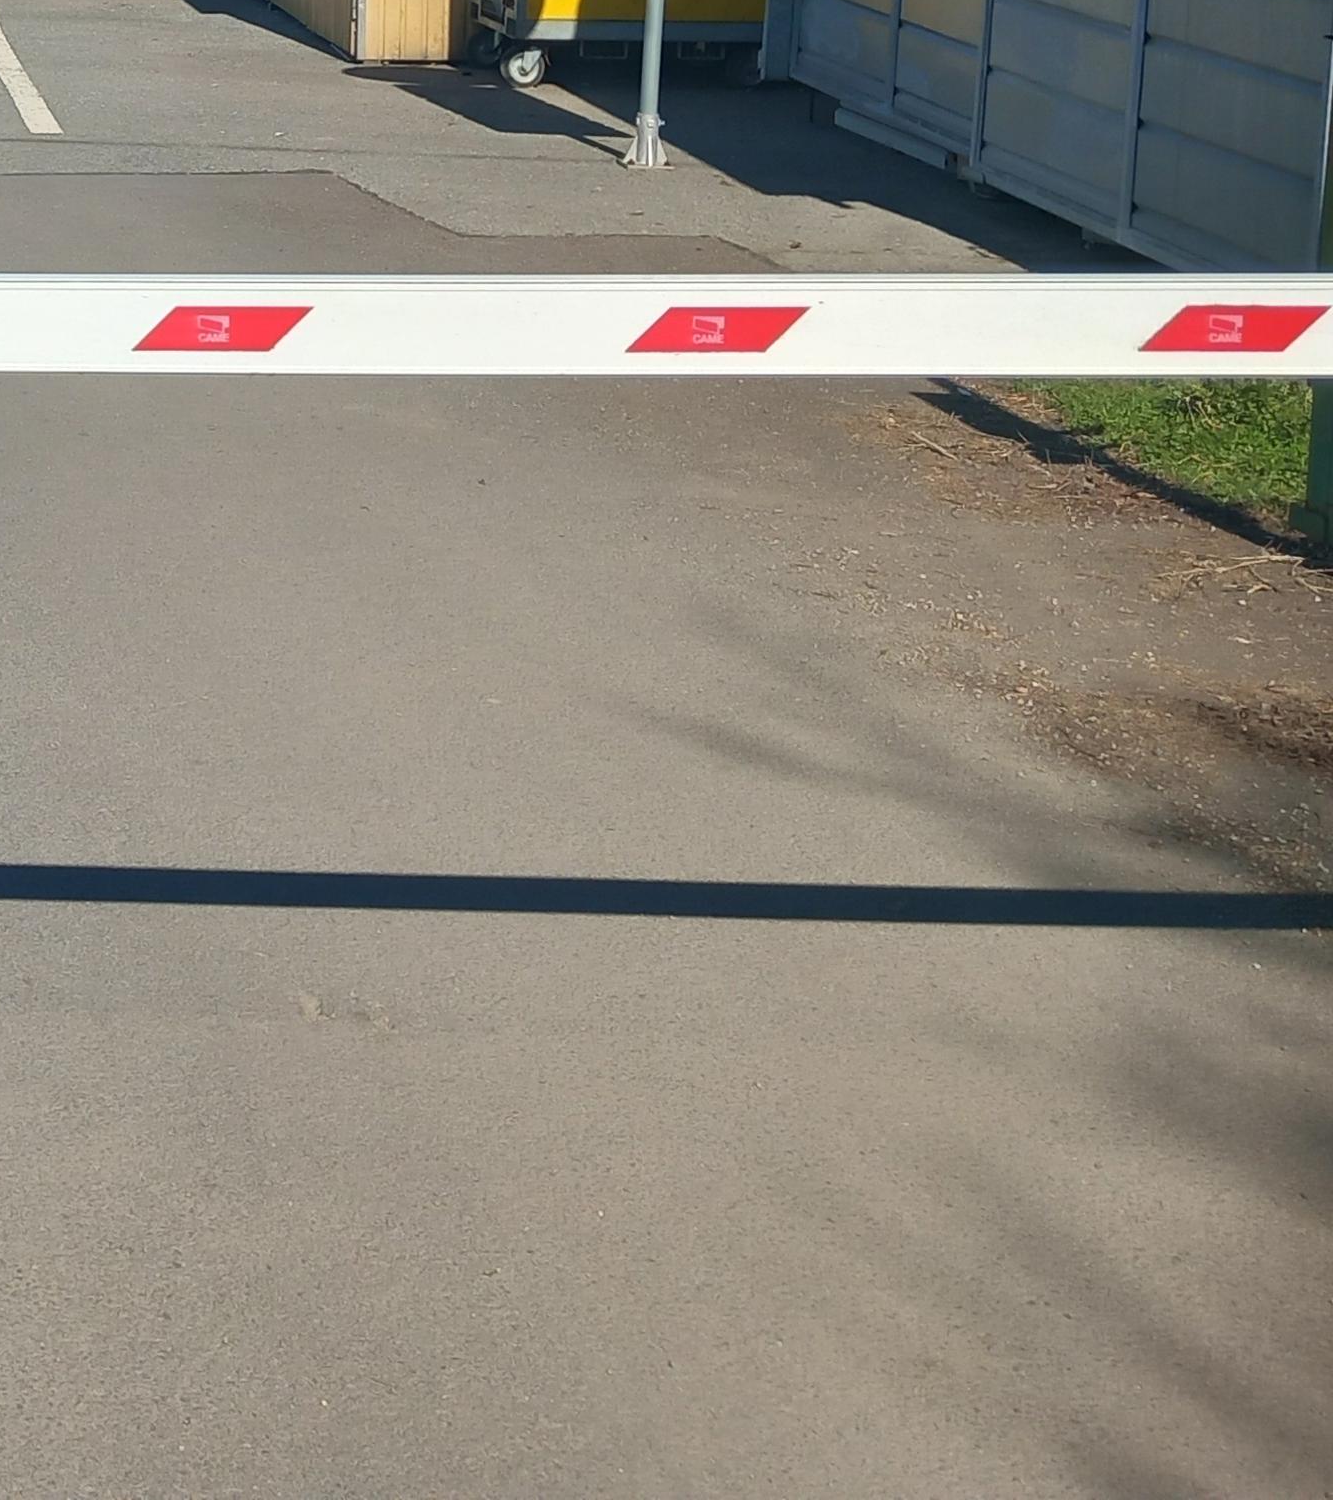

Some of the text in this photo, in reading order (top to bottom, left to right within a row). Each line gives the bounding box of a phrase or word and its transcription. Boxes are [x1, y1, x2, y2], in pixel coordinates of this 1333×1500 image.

[198, 333, 229, 342] CAME
[693, 334, 724, 344] CAME
[1209, 333, 1242, 343] CAME
